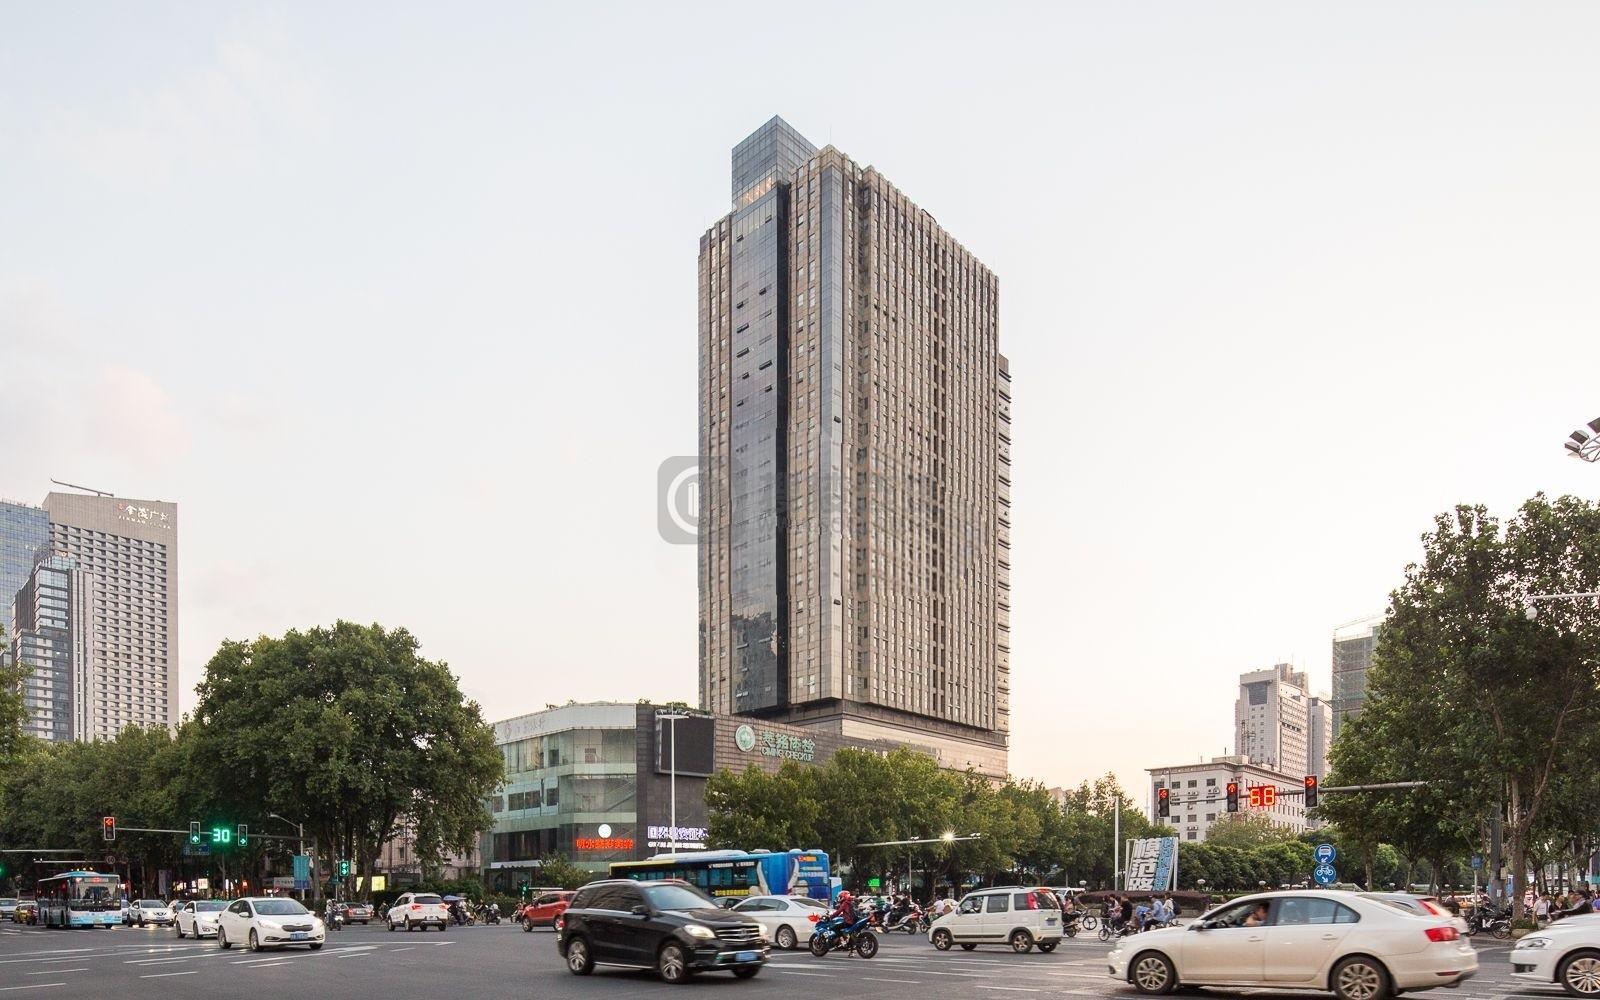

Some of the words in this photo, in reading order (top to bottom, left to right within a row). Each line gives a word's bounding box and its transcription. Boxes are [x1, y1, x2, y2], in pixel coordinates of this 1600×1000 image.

[1250, 787, 1275, 807] 68
[213, 828, 230, 843] 30
[1128, 838, 1161, 891] 模范路
